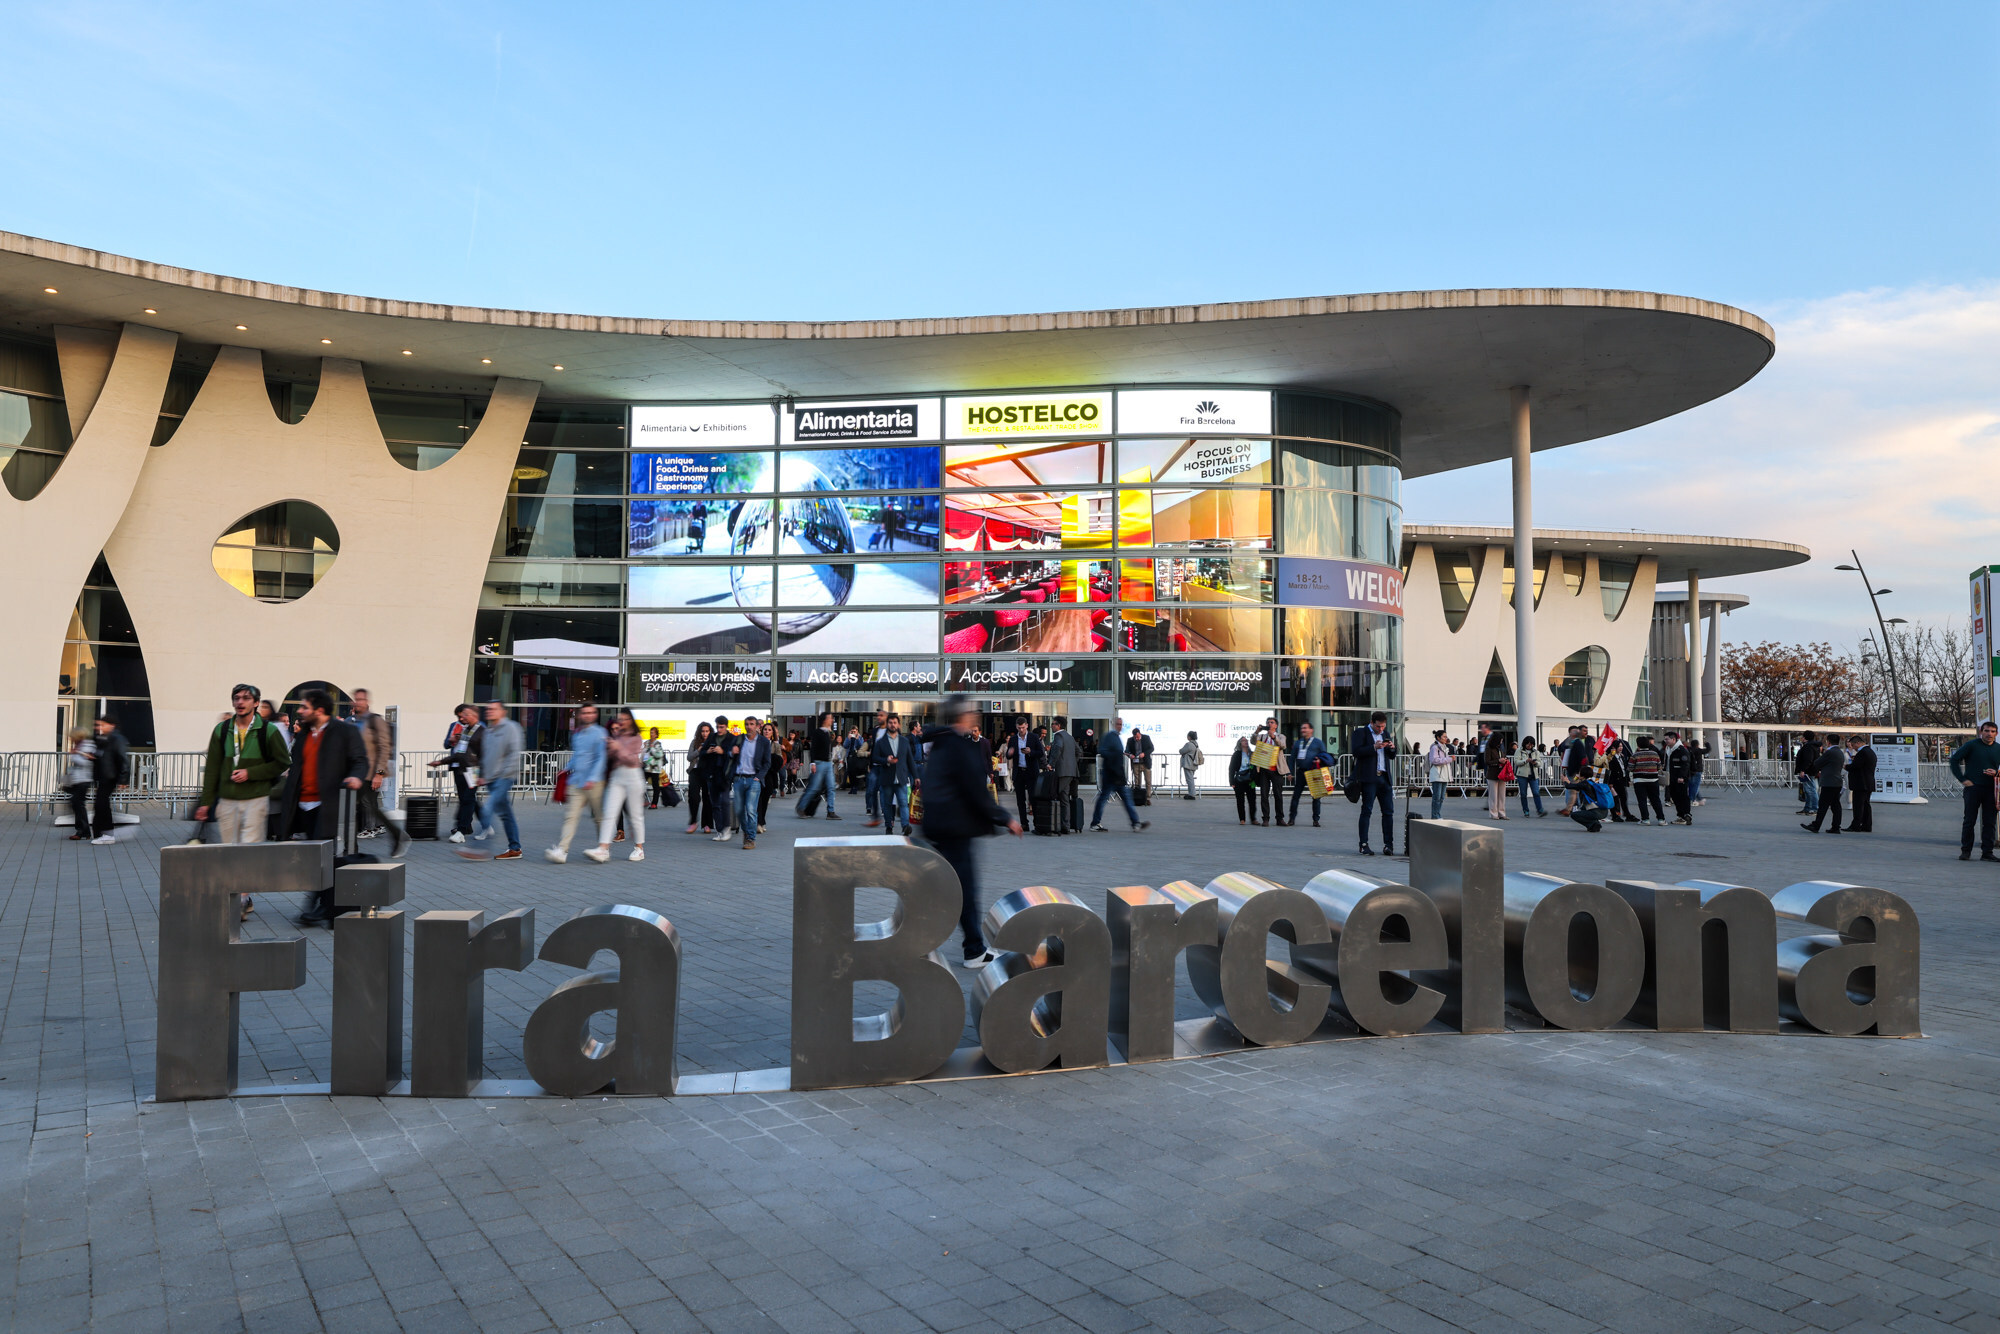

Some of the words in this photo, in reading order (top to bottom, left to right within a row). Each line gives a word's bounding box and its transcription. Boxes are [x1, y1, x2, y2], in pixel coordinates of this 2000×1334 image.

[968, 402, 1098, 424] HOSTELCO
[799, 409, 913, 430] Alimentaria
[1197, 416, 1236, 425] Barcelona
[640, 424, 687, 433] Alimentaria
[704, 422, 747, 432] Exhibitions
[1197, 447, 1232, 460] FOCUS
[1235, 444, 1251, 454] ON
[665, 456, 694, 466] unique
[1184, 454, 1251, 472] HOSPITALITY
[656, 466, 680, 474] Food,
[682, 465, 708, 473] Drinks
[1200, 464, 1252, 479] BUSINESS
[656, 474, 708, 483] Gastronomy
[656, 483, 703, 492] Experience
[1296, 574, 1322, 584] 18-21
[1346, 569, 1402, 608] WELCO
[642, 673, 709, 682] EXPOSITORES
[712, 673, 718, 682] Y
[721, 673, 760, 682] PRENSA
[807, 668, 858, 684] Accés
[878, 669, 936, 684] Acceso
[959, 668, 1018, 683] Access
[1024, 667, 1062, 683] SUD
[1128, 671, 1187, 681] VISITANTES
[1189, 671, 1263, 681] ACREDITADOS
[645, 683, 700, 692] EXHIBITORS
[701, 683, 722, 692] AND
[724, 683, 755, 692] PRESS
[1141, 681, 1204, 691] REGISTERED
[1205, 681, 1250, 691] VISITORS
[157, 840, 682, 1102] Fira
[791, 819, 1921, 1092] Barcelona
